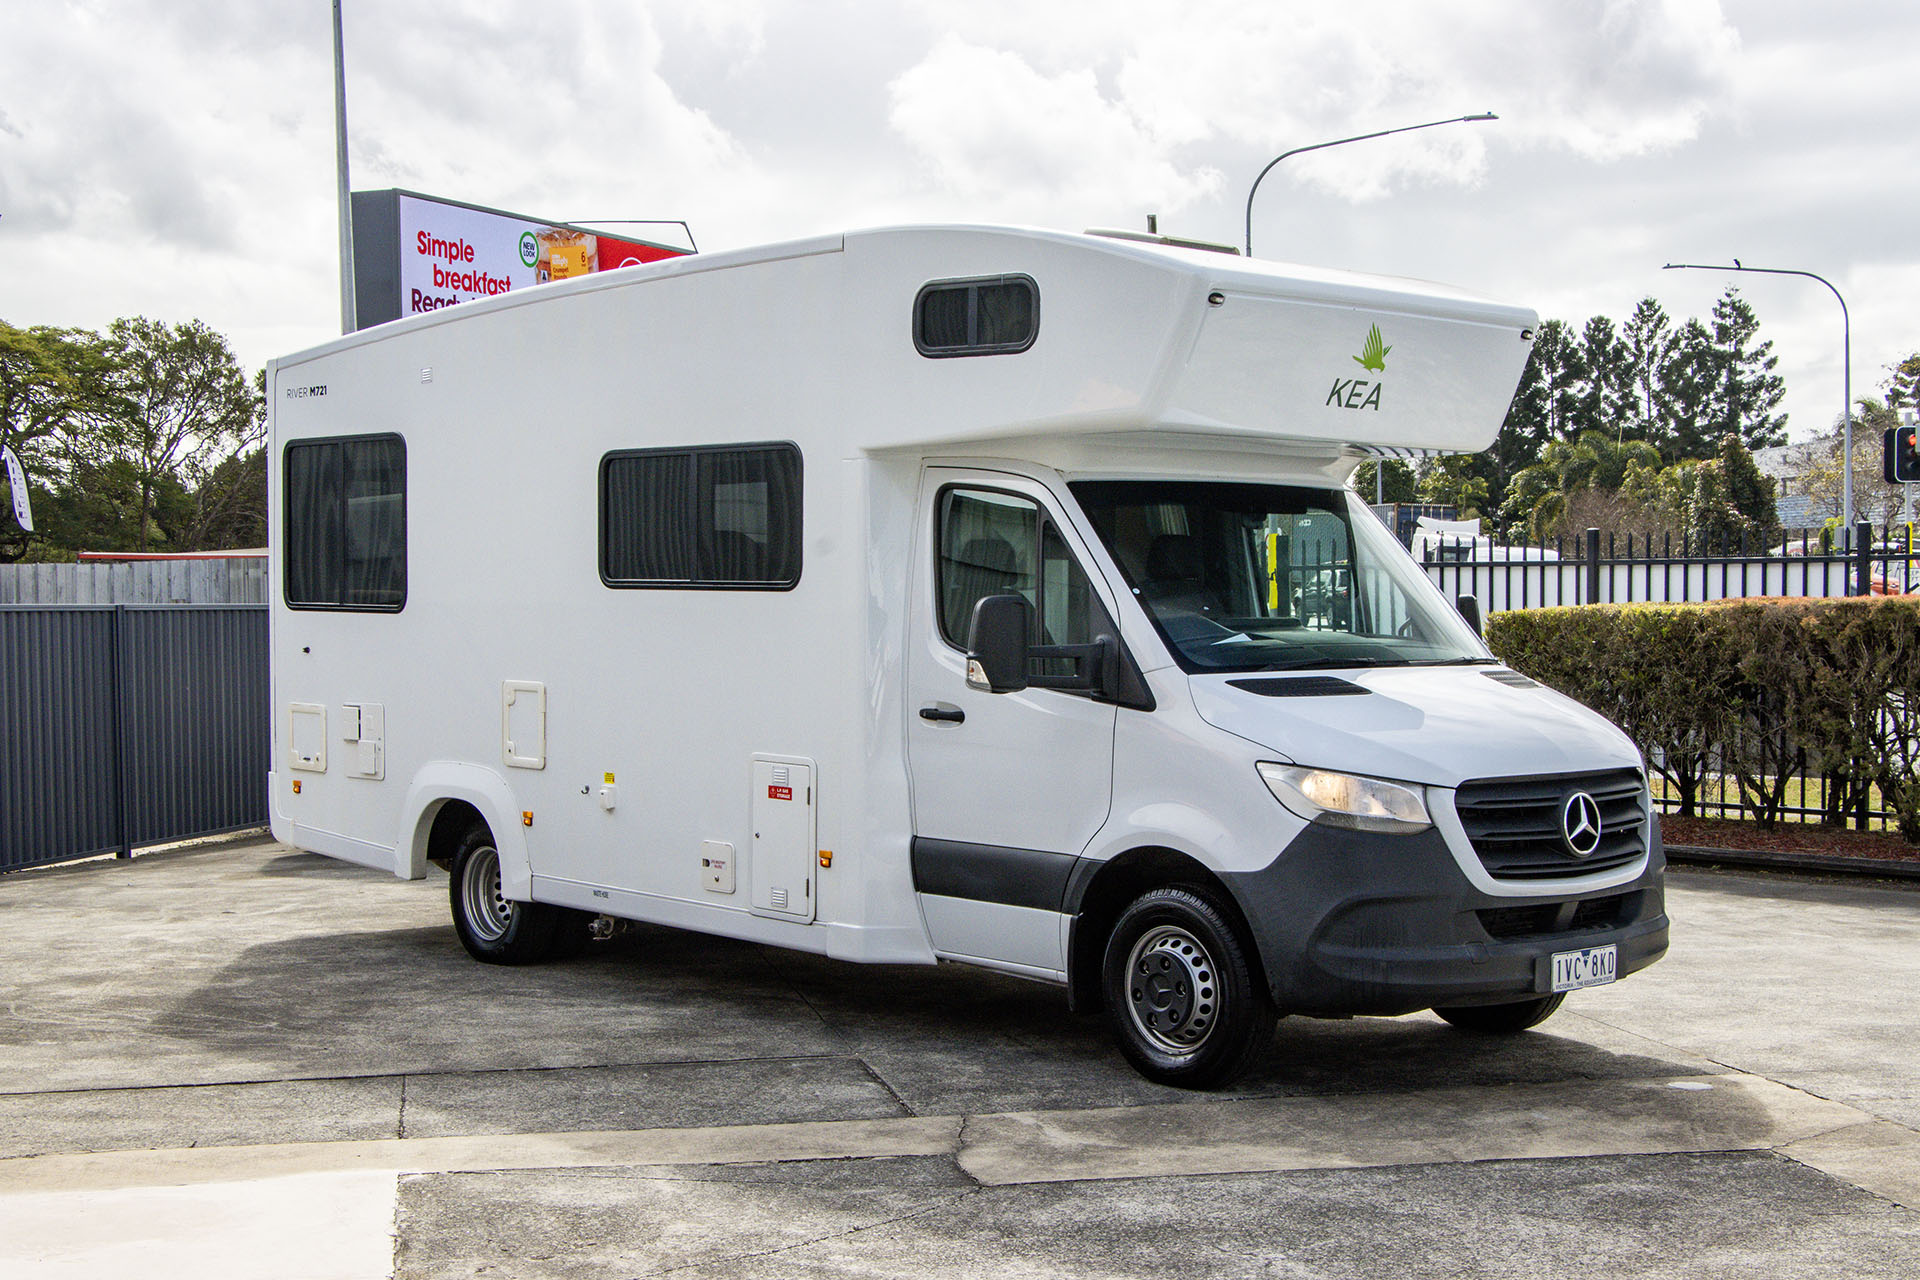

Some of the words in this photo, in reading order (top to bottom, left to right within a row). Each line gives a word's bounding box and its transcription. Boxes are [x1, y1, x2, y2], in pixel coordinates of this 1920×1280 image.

[417, 230, 474, 264] Simple
[523, 242, 535, 251] NEW
[581, 252, 586, 263] 6
[433, 263, 511, 296] breakfast
[286, 386, 308, 398] RIVER
[310, 385, 327, 396] M721
[1326, 378, 1382, 411] KEA
[1557, 957, 1581, 982] 1VC
[1592, 952, 1614, 976] 8KD
